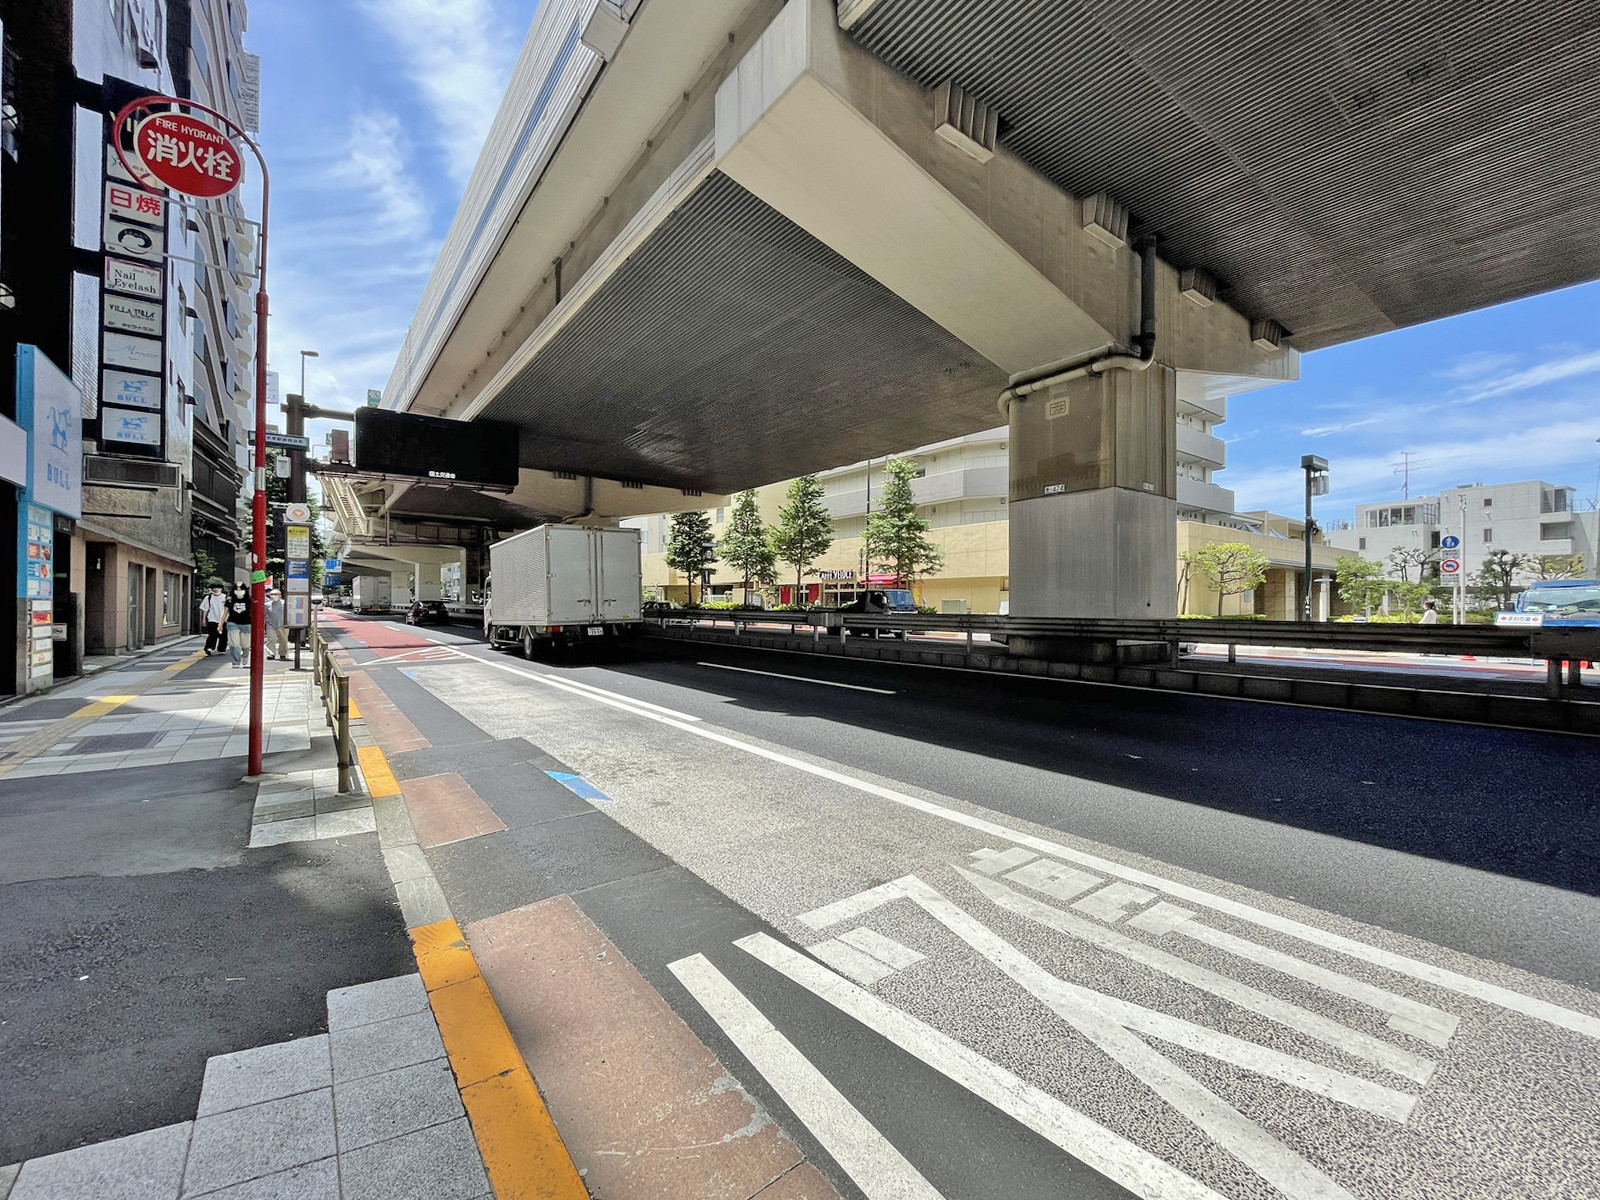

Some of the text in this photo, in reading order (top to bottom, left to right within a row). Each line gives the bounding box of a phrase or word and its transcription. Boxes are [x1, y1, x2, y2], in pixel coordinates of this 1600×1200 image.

[156, 117, 178, 132] FIRE
[181, 125, 224, 145] HYDRANT
[147, 130, 234, 182] 消火栓
[110, 188, 161, 217] 日焼
[114, 269, 136, 281] Nail
[114, 278, 157, 294] Eyelash
